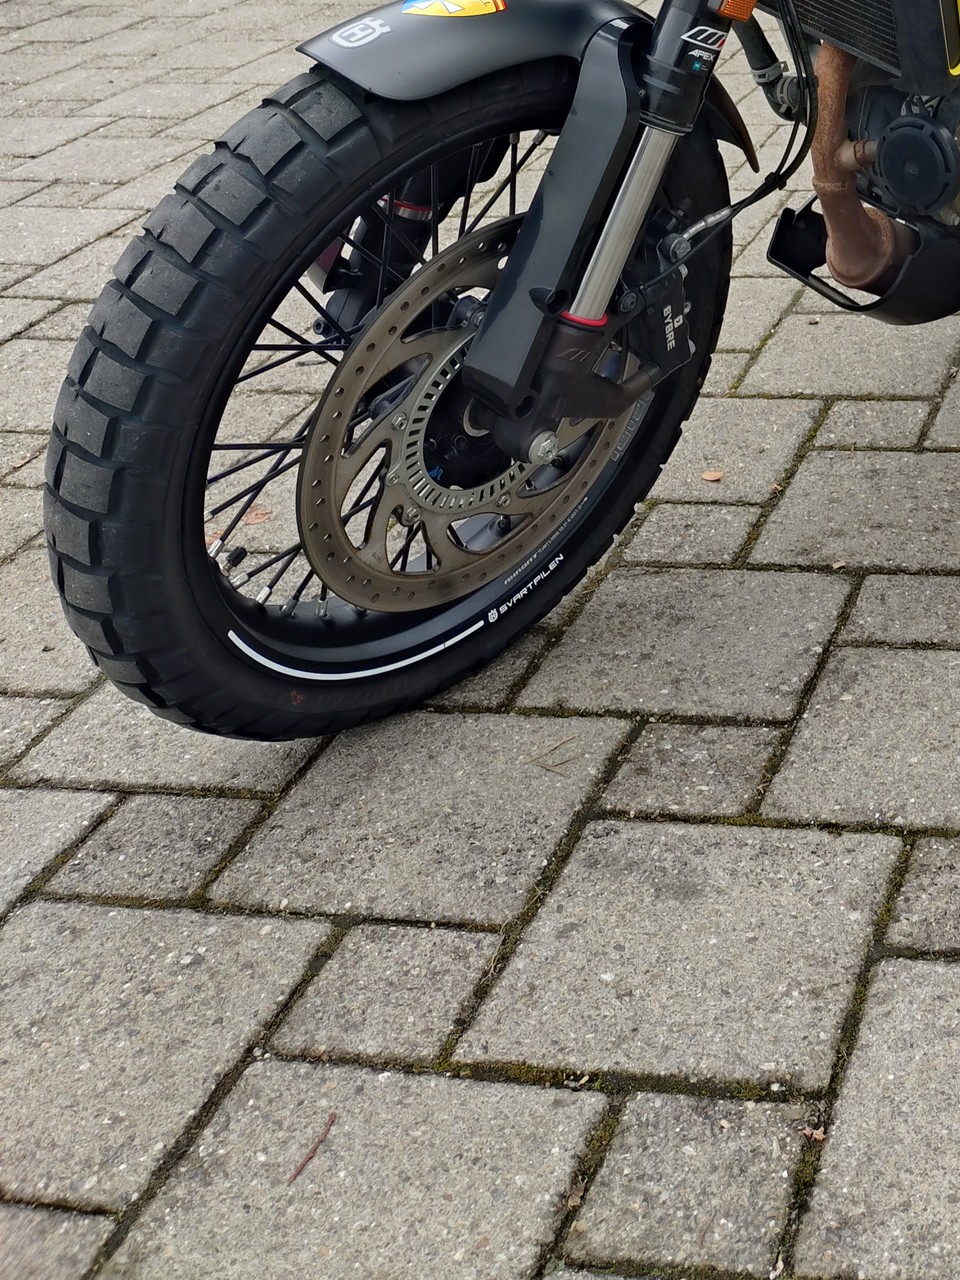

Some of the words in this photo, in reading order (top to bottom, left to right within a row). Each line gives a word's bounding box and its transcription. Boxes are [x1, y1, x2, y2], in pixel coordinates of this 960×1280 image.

[687, 48, 716, 62] APEX
[663, 305, 676, 352] BYBRE
[499, 553, 564, 615] SVARTPILEN
